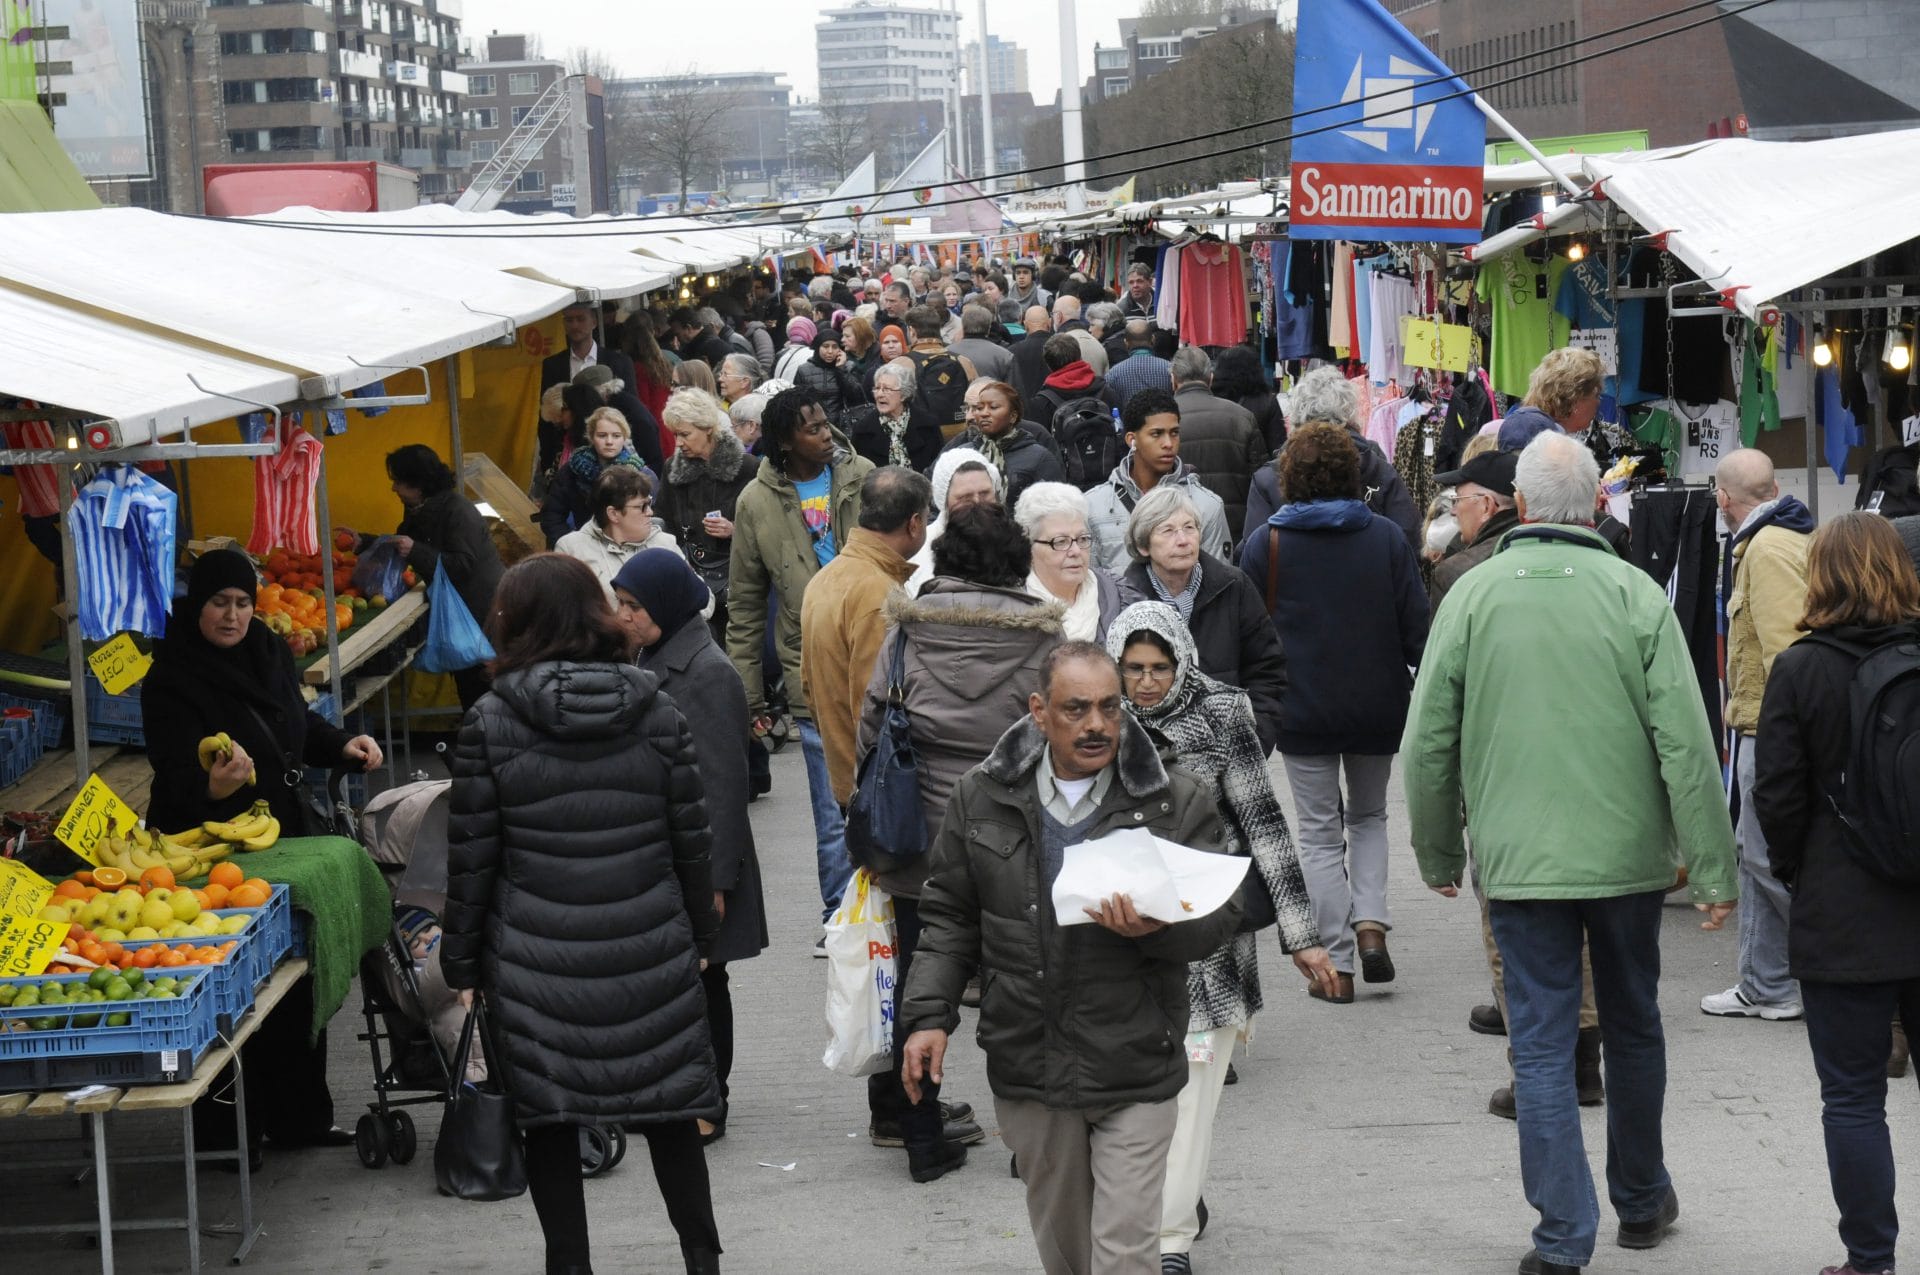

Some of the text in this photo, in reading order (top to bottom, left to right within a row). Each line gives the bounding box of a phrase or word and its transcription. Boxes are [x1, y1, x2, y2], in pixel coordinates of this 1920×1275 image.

[1427, 148, 1439, 156] TM
[1300, 167, 1473, 221] Sanmarino
[1700, 442, 1719, 459] RS
